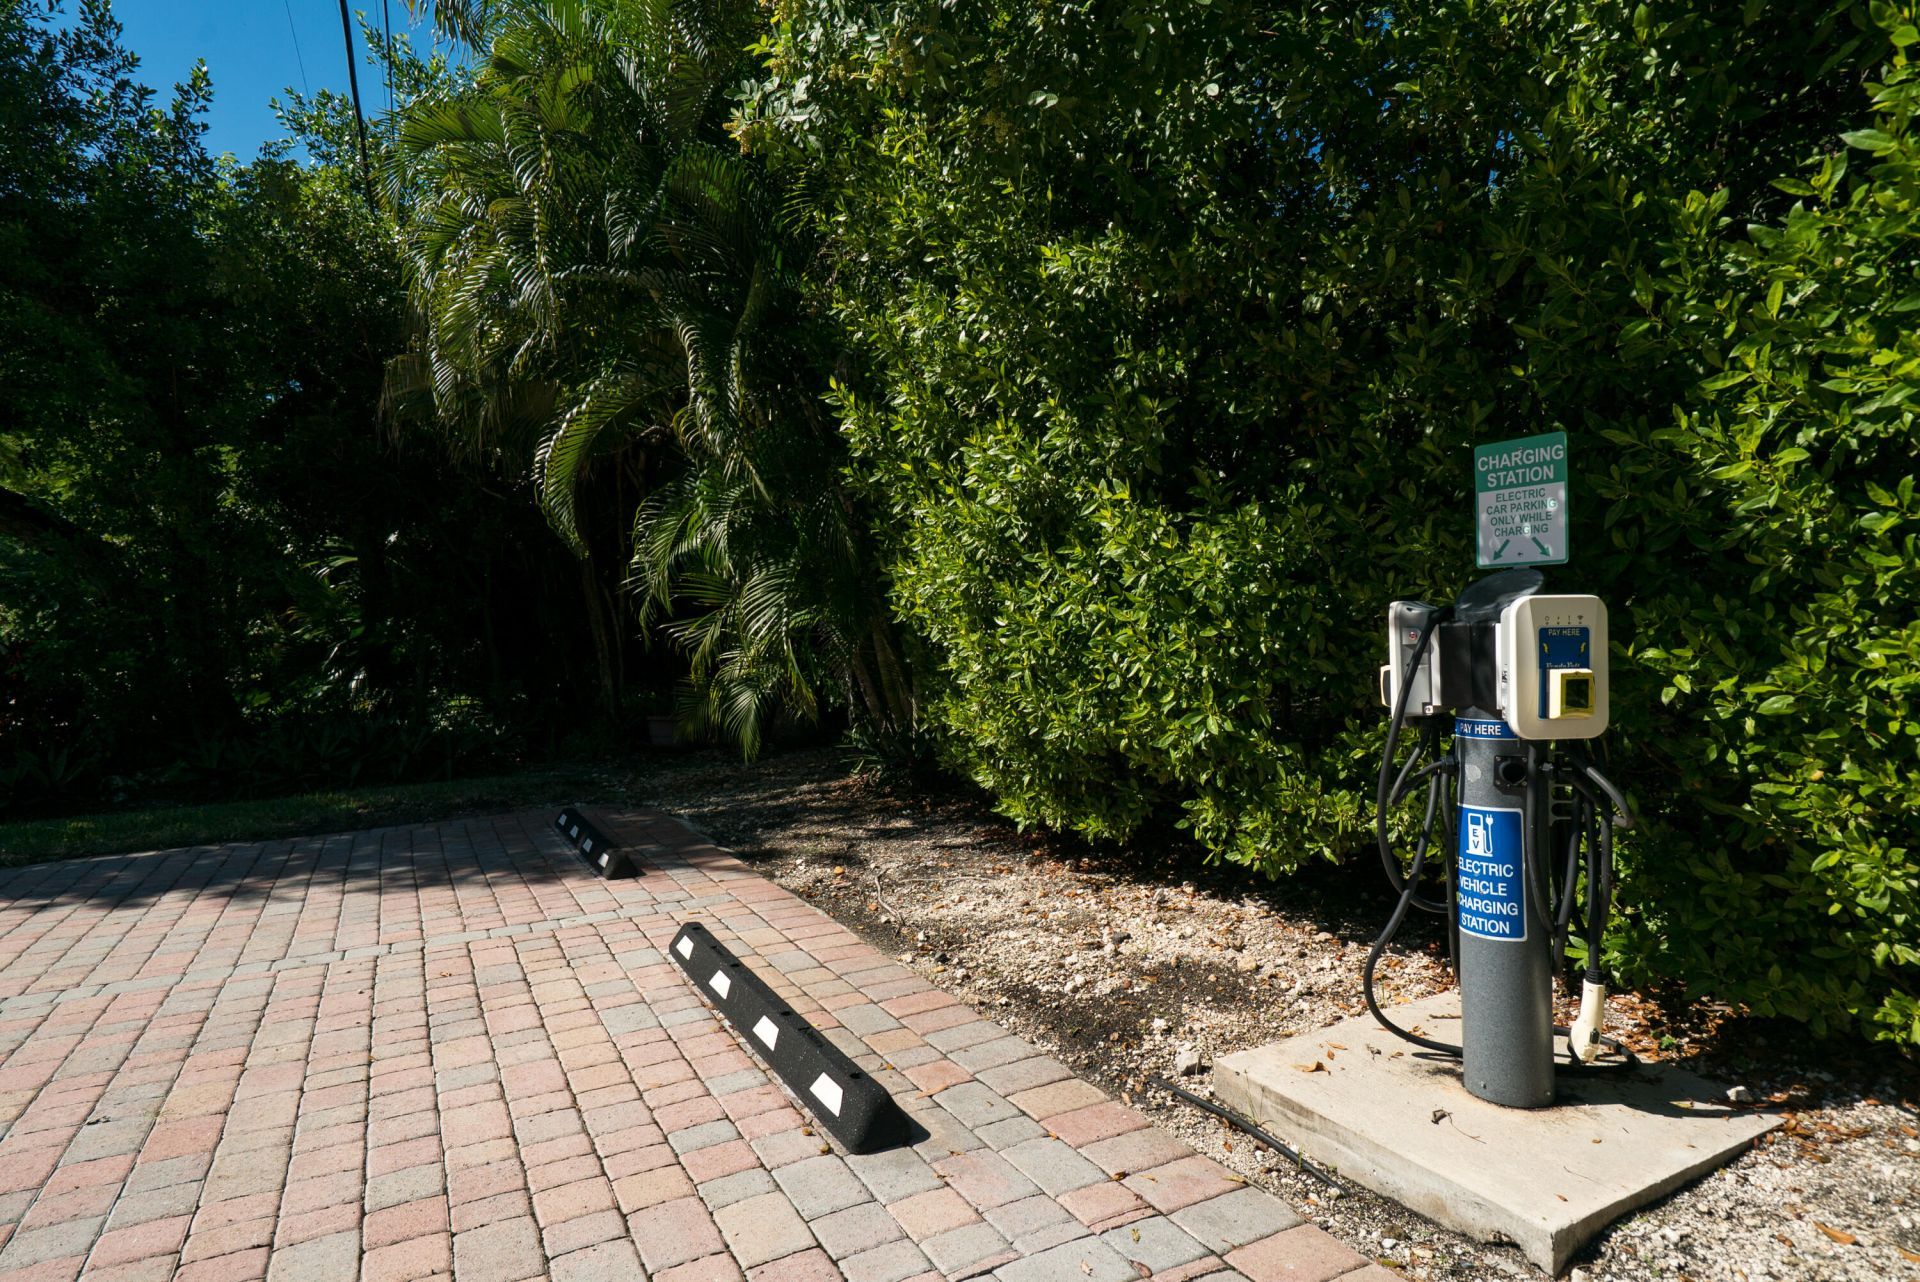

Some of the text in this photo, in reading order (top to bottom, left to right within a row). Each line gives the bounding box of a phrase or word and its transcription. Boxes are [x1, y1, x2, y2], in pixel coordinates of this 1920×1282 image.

[1478, 444, 1564, 471] CHARGING
[1487, 464, 1554, 488] STATION
[1496, 488, 1546, 502] ELECTRIC
[1486, 498, 1557, 515] CAR PARKING
[1490, 511, 1553, 526] ONLY WHILE
[1494, 523, 1549, 538] CHARGING
[1548, 628, 1581, 637] PAY HERE
[1460, 722, 1502, 736] PAY HERE
[1458, 856, 1514, 878] ELECTRIC
[1459, 875, 1507, 896] VEHICLE
[1461, 912, 1510, 934] STATION
